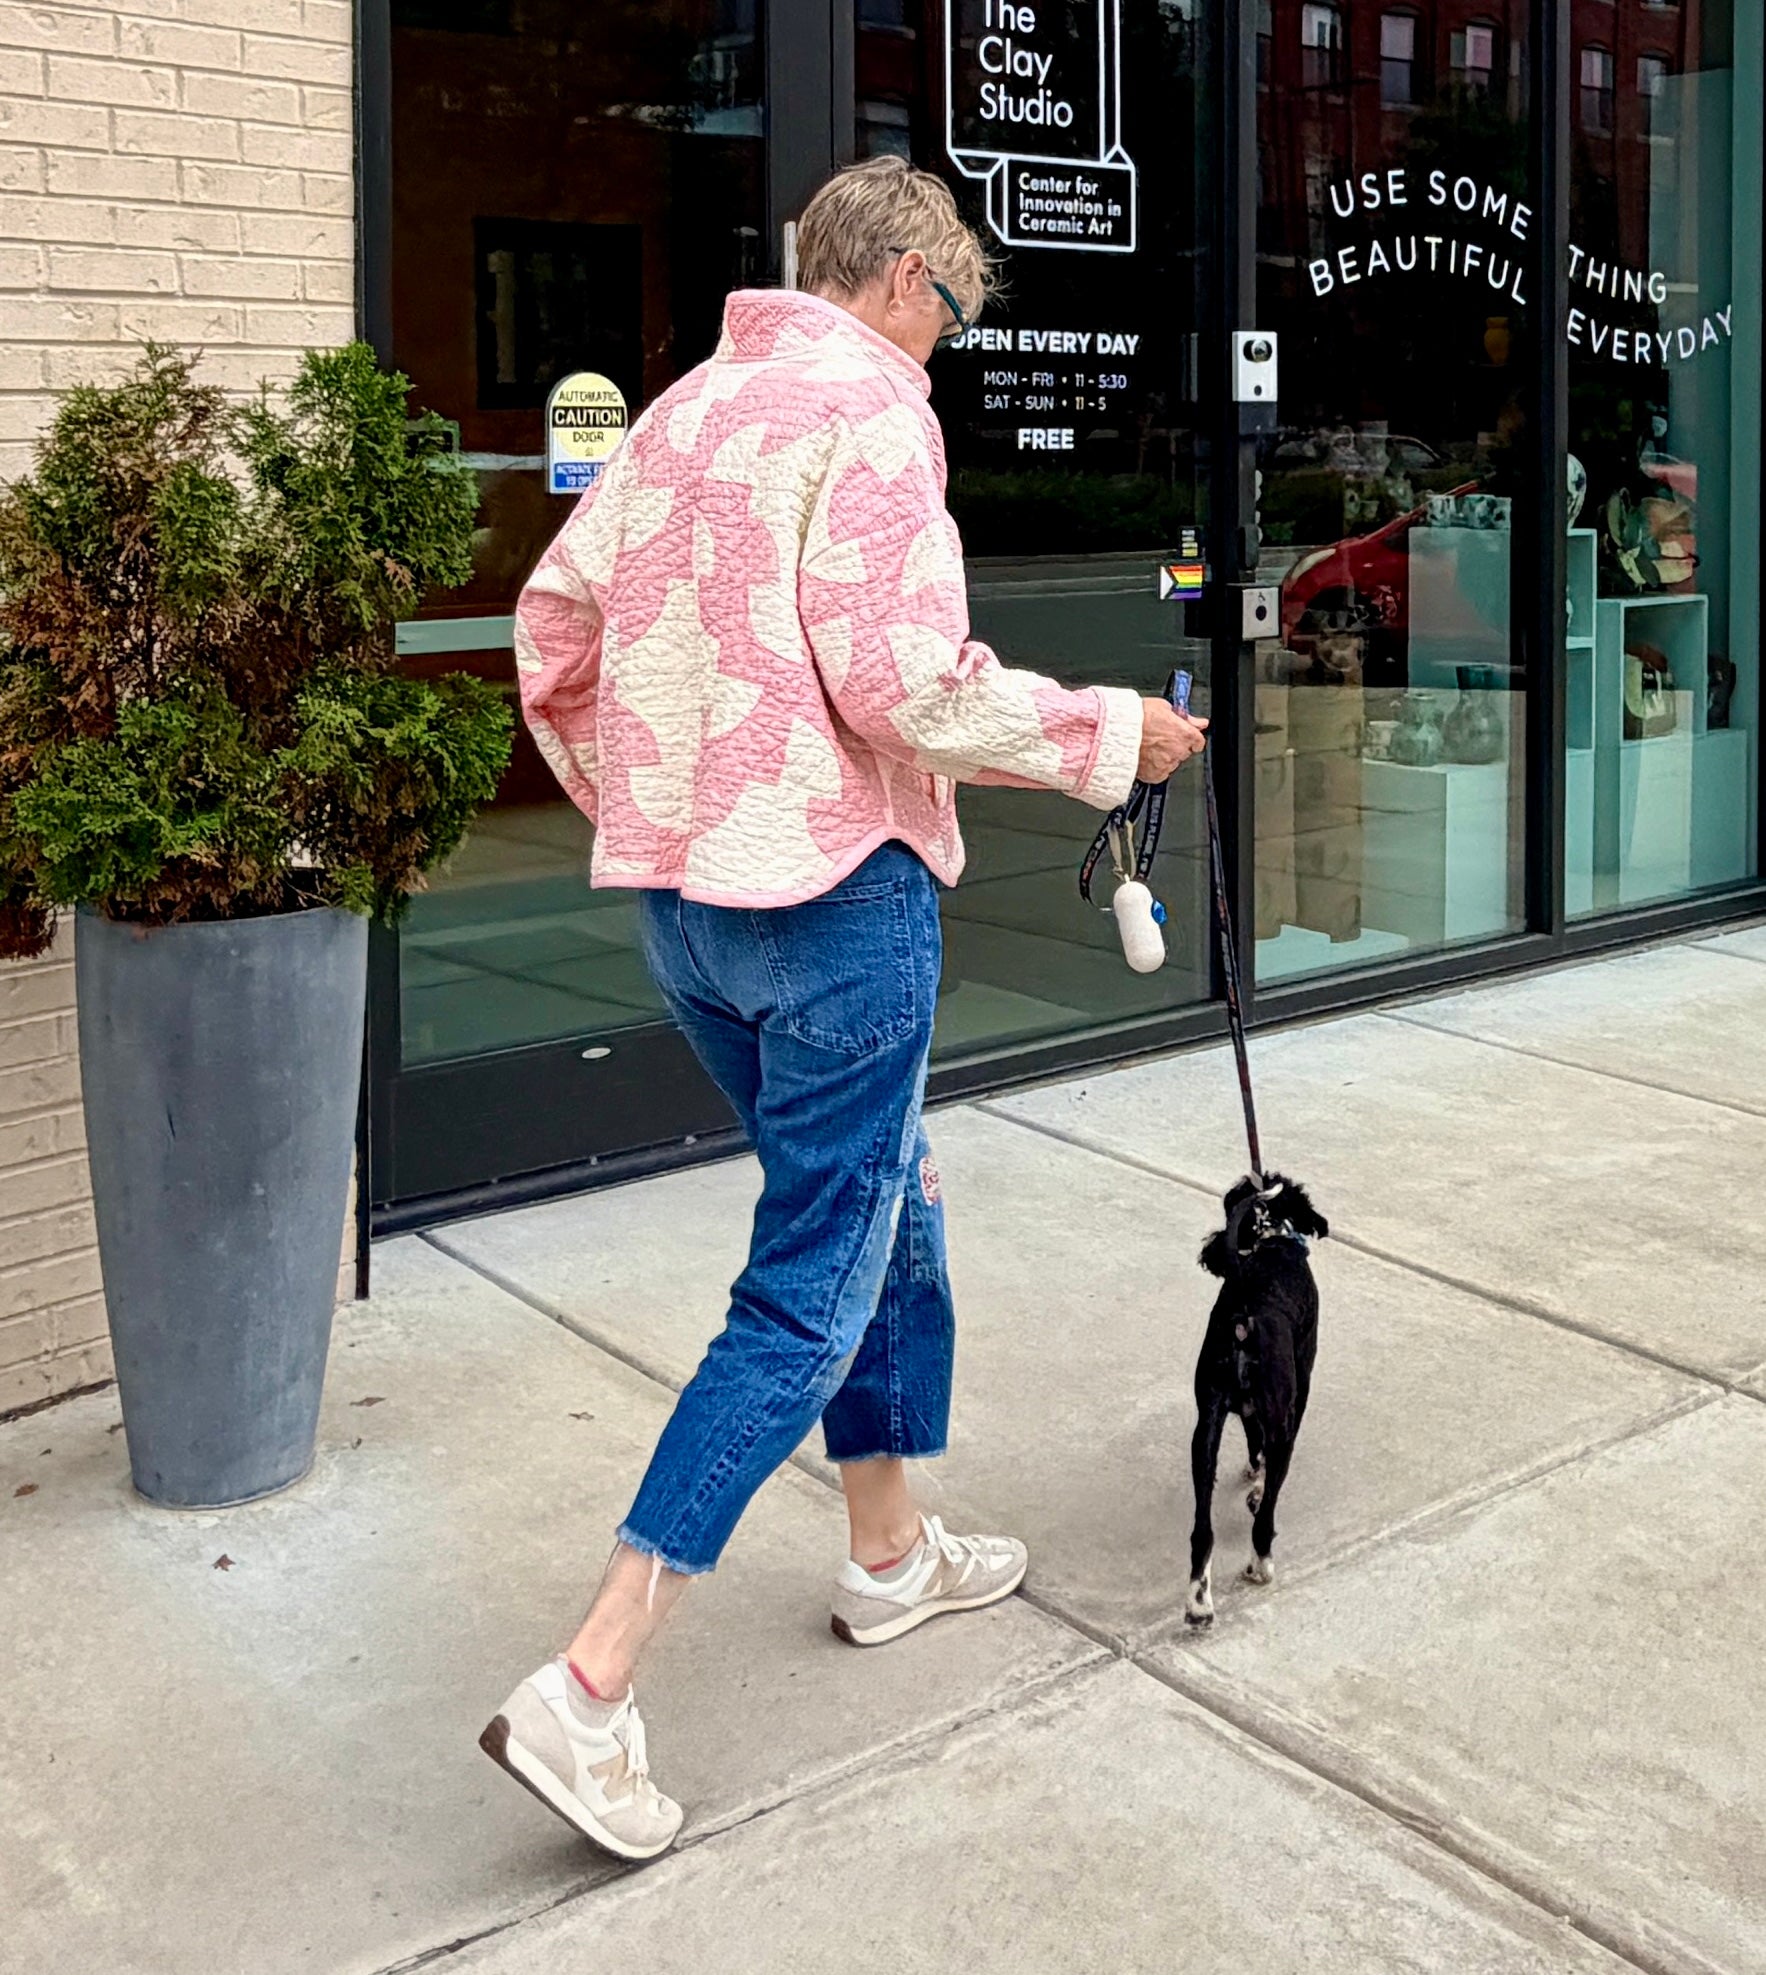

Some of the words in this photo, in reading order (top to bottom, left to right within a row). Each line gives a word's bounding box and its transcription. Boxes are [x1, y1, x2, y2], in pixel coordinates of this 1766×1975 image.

[979, 36, 1053, 85] Clay
[980, 82, 1073, 127] Studio
[1019, 172, 1071, 193] Center
[1076, 176, 1098, 195] for
[1019, 192, 1103, 215] Innovation
[1108, 199, 1121, 216] in
[1019, 212, 1084, 234] Ceramic
[1088, 218, 1112, 235] Art
[1331, 170, 1407, 216] USE
[1428, 170, 1532, 241] SOME
[1569, 245, 1666, 303] THING
[1309, 235, 1527, 305] BEAUTIFUL
[1567, 304, 1733, 364] EVERYDAY
[1019, 330, 1091, 353] EVERY
[1097, 333, 1139, 355] DAY
[984, 371, 1017, 385] MON
[1033, 372, 1053, 386] FRI
[558, 390, 618, 402] AUTOMATIC
[985, 395, 1010, 409] SAT
[1026, 396, 1054, 410] SUN
[555, 408, 622, 425] CAUTION
[572, 431, 605, 442] DOOR
[1018, 428, 1074, 450] FREE
